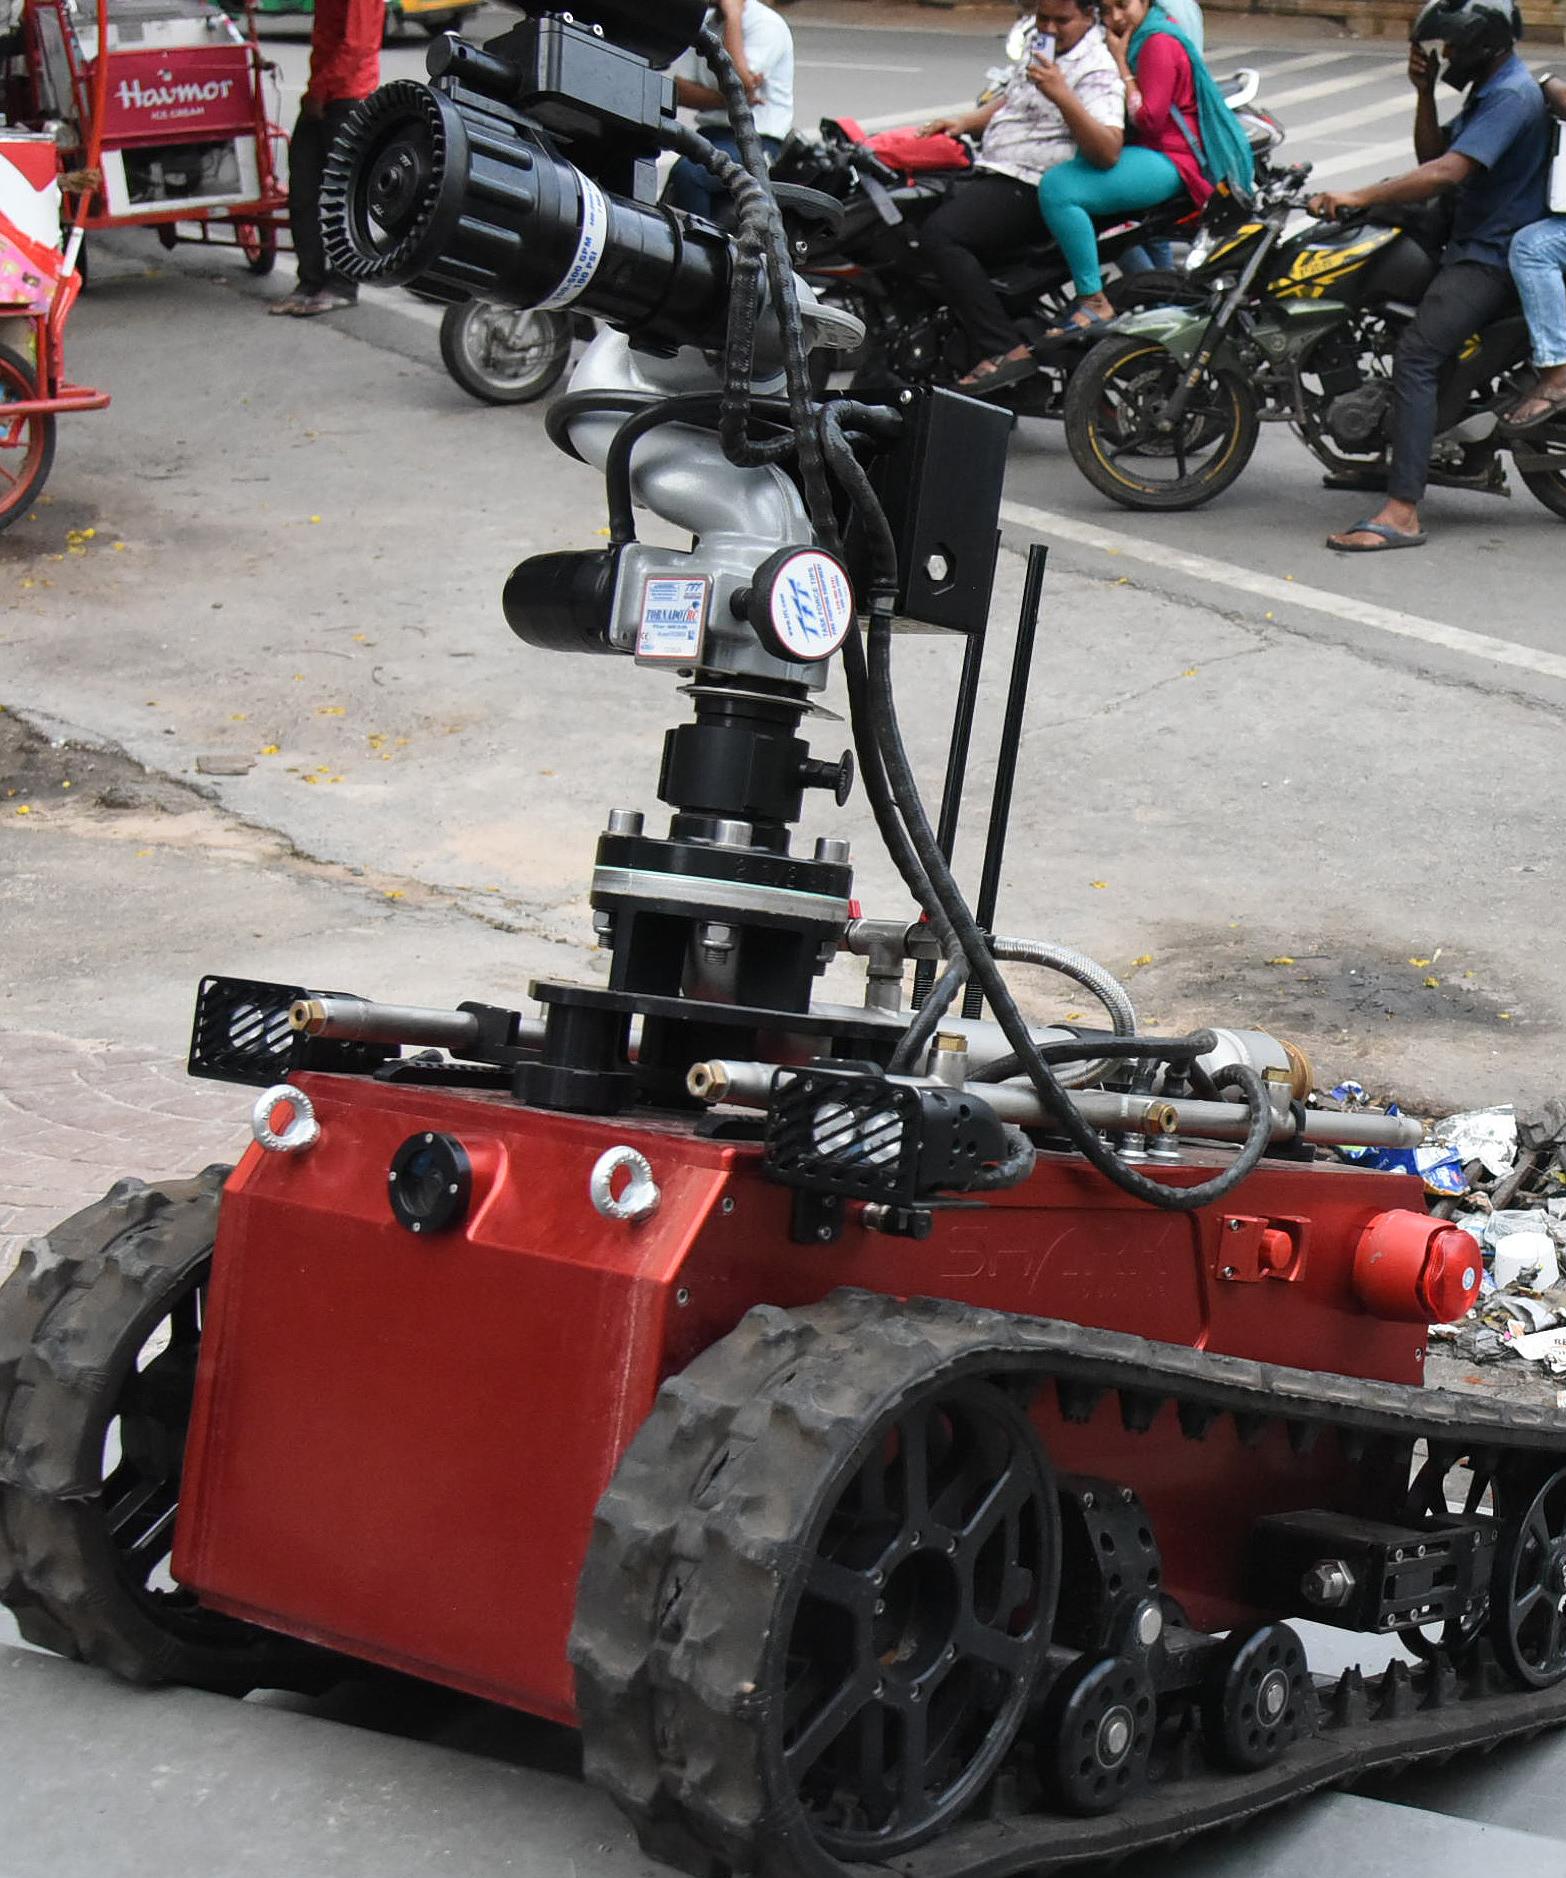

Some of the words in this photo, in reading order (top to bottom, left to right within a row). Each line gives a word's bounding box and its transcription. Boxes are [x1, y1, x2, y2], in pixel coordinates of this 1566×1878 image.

[579, 236, 593, 262] GPM
[573, 271, 590, 288] 100
[585, 251, 598, 270] PSI
[787, 577, 820, 643] TFT
